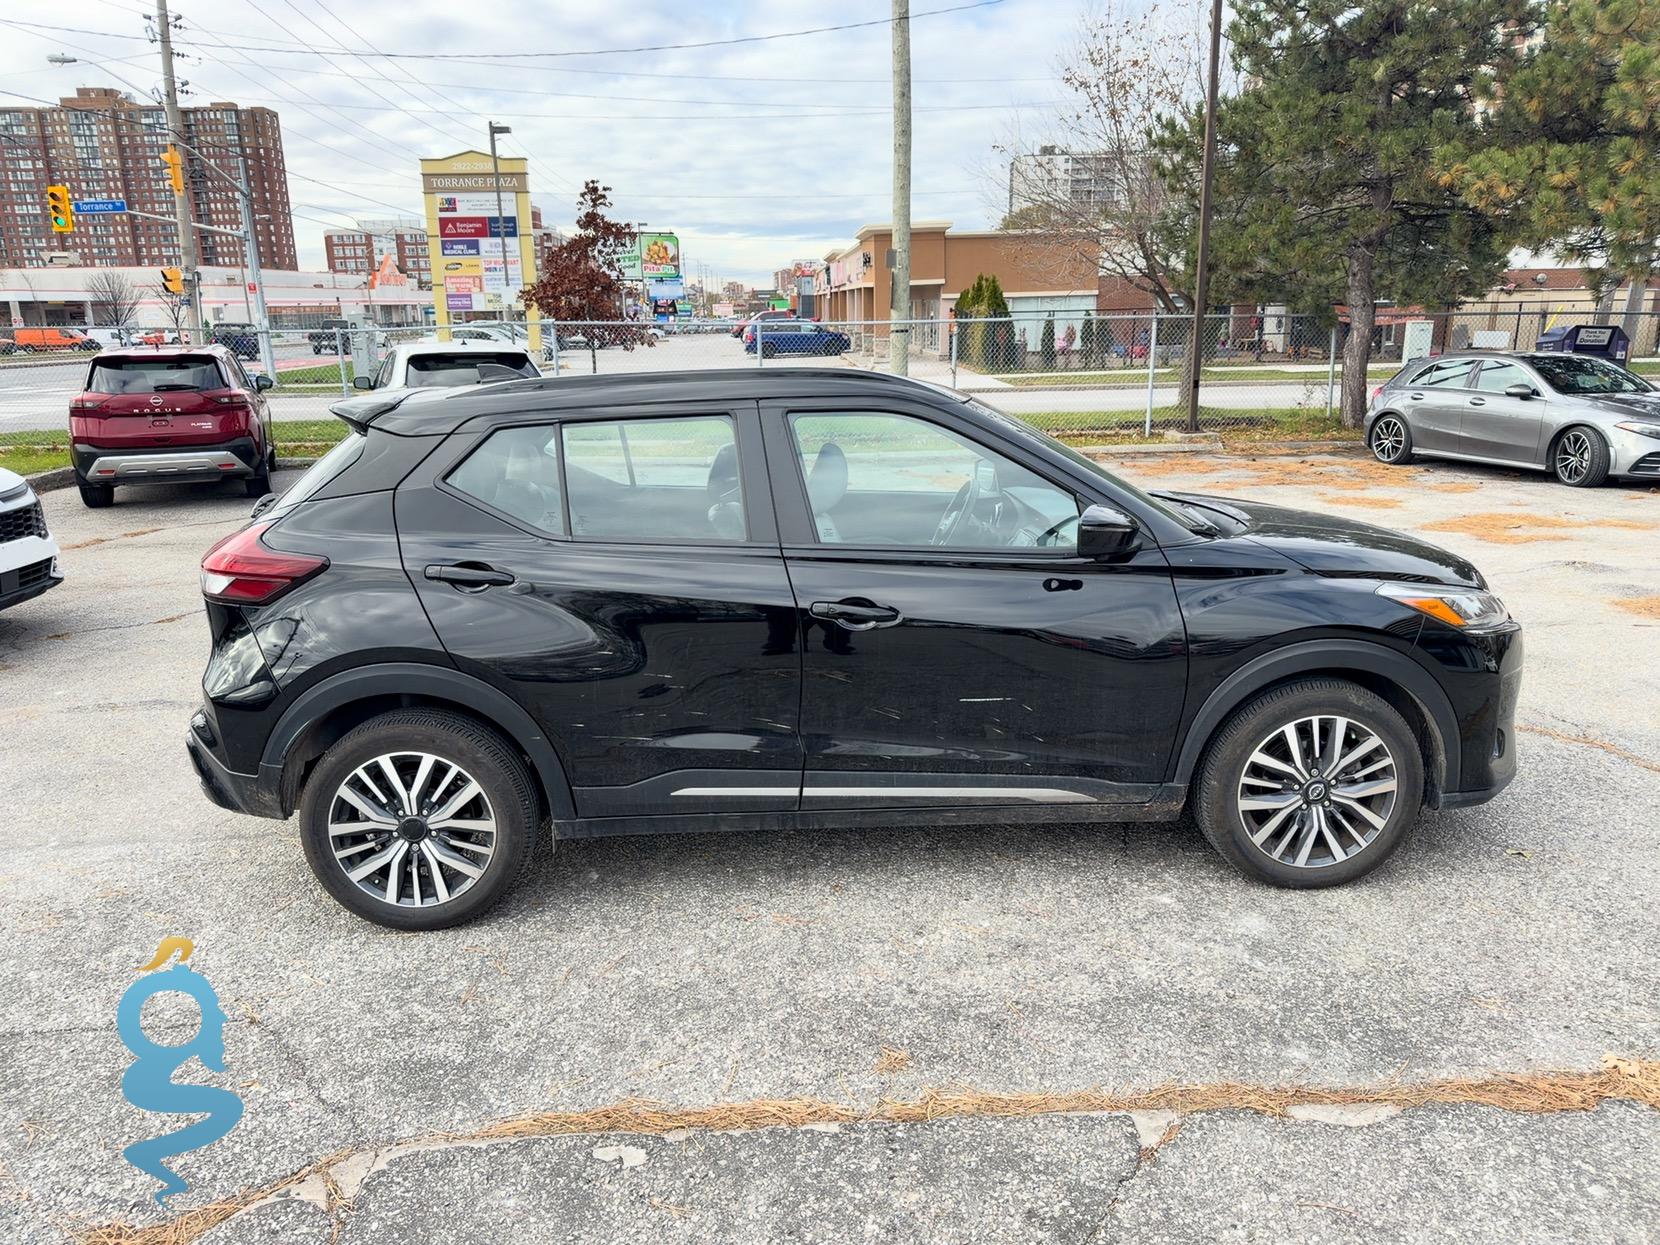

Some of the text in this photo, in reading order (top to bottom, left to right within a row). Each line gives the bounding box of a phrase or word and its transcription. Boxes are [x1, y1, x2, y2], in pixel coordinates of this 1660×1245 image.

[431, 177, 518, 187] TORRANCE PLAZA
[78, 202, 113, 211] Torrance
